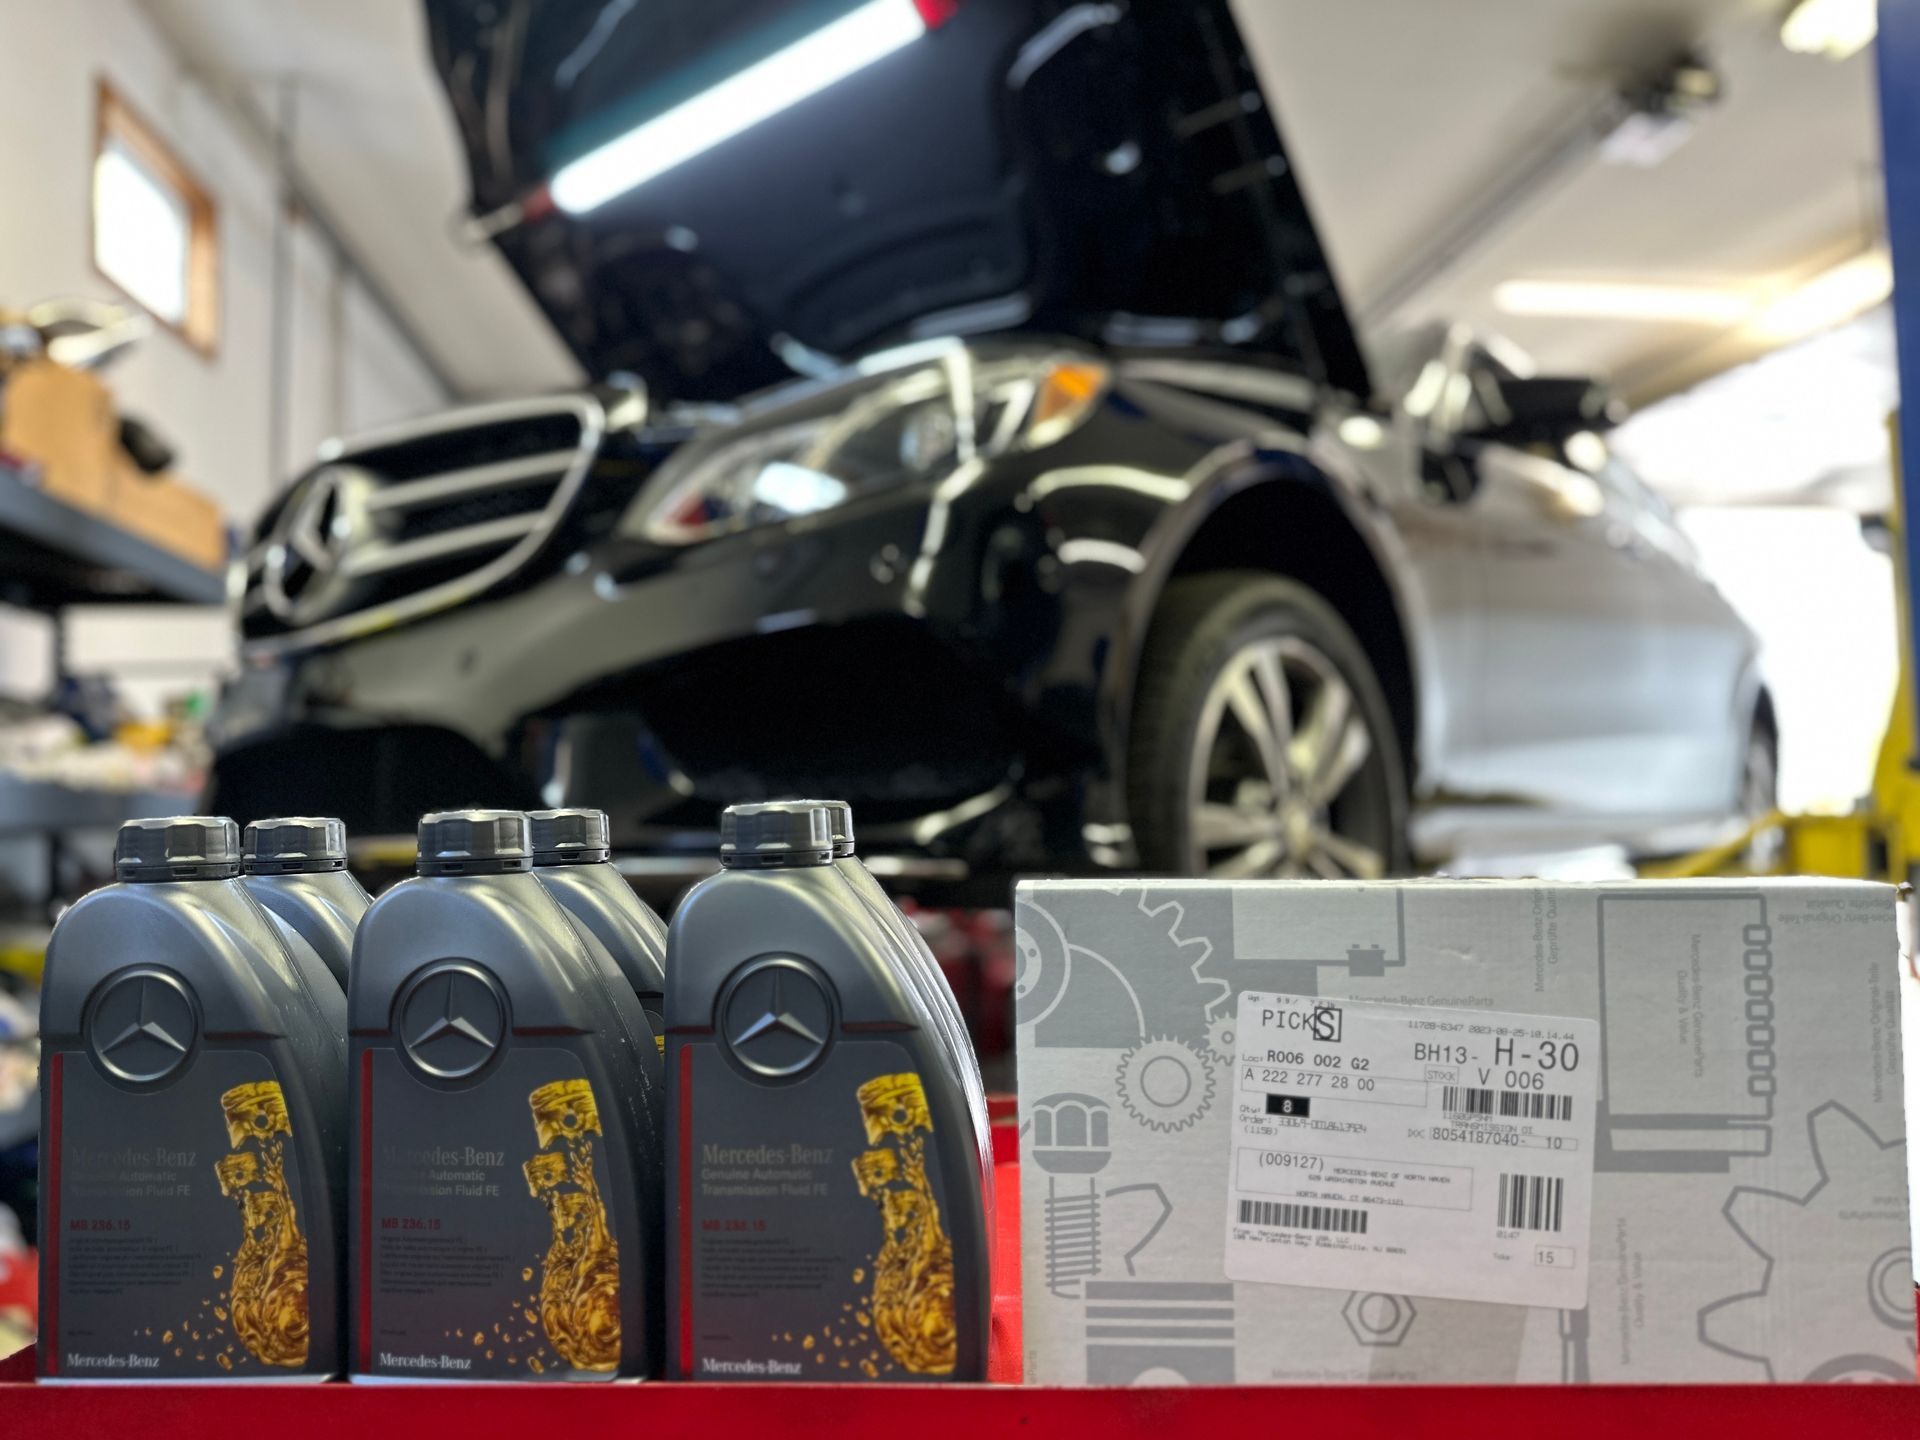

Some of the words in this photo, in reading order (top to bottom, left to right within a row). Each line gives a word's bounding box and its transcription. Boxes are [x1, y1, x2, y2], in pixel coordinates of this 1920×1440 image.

[1267, 1050, 1305, 1065] R006
[1313, 1054, 1342, 1069] 002
[1350, 1057, 1370, 1071] G2
[1495, 1037, 1579, 1072] H-30
[1244, 1067, 1255, 1081] A
[1262, 1069, 1288, 1084] 222
[1296, 1072, 1323, 1087] 277
[1331, 1075, 1349, 1089] 28
[1357, 1078, 1375, 1092] 00
[1427, 1070, 1456, 1082] STOCK
[1478, 1067, 1491, 1085] V
[1505, 1070, 1544, 1090] 006
[1283, 1099, 1292, 1113] 8
[1545, 1136, 1562, 1150] 10
[383, 1146, 505, 1167] Mcedes-Benz
[702, 1143, 834, 1165] Mercedes-Benz
[1258, 1152, 1325, 1173] (009127)
[176, 1184, 191, 1197] FE
[455, 1184, 482, 1197] Fluid
[486, 1184, 500, 1197] FE
[381, 1217, 399, 1229] MB
[402, 1218, 441, 1230] 236.15
[1537, 1250, 1555, 1265] 15
[67, 1352, 160, 1368] Mercedes-Benz
[379, 1352, 472, 1370] Mercedes-Benz
[702, 1357, 802, 1374] Mercedes-Benz
